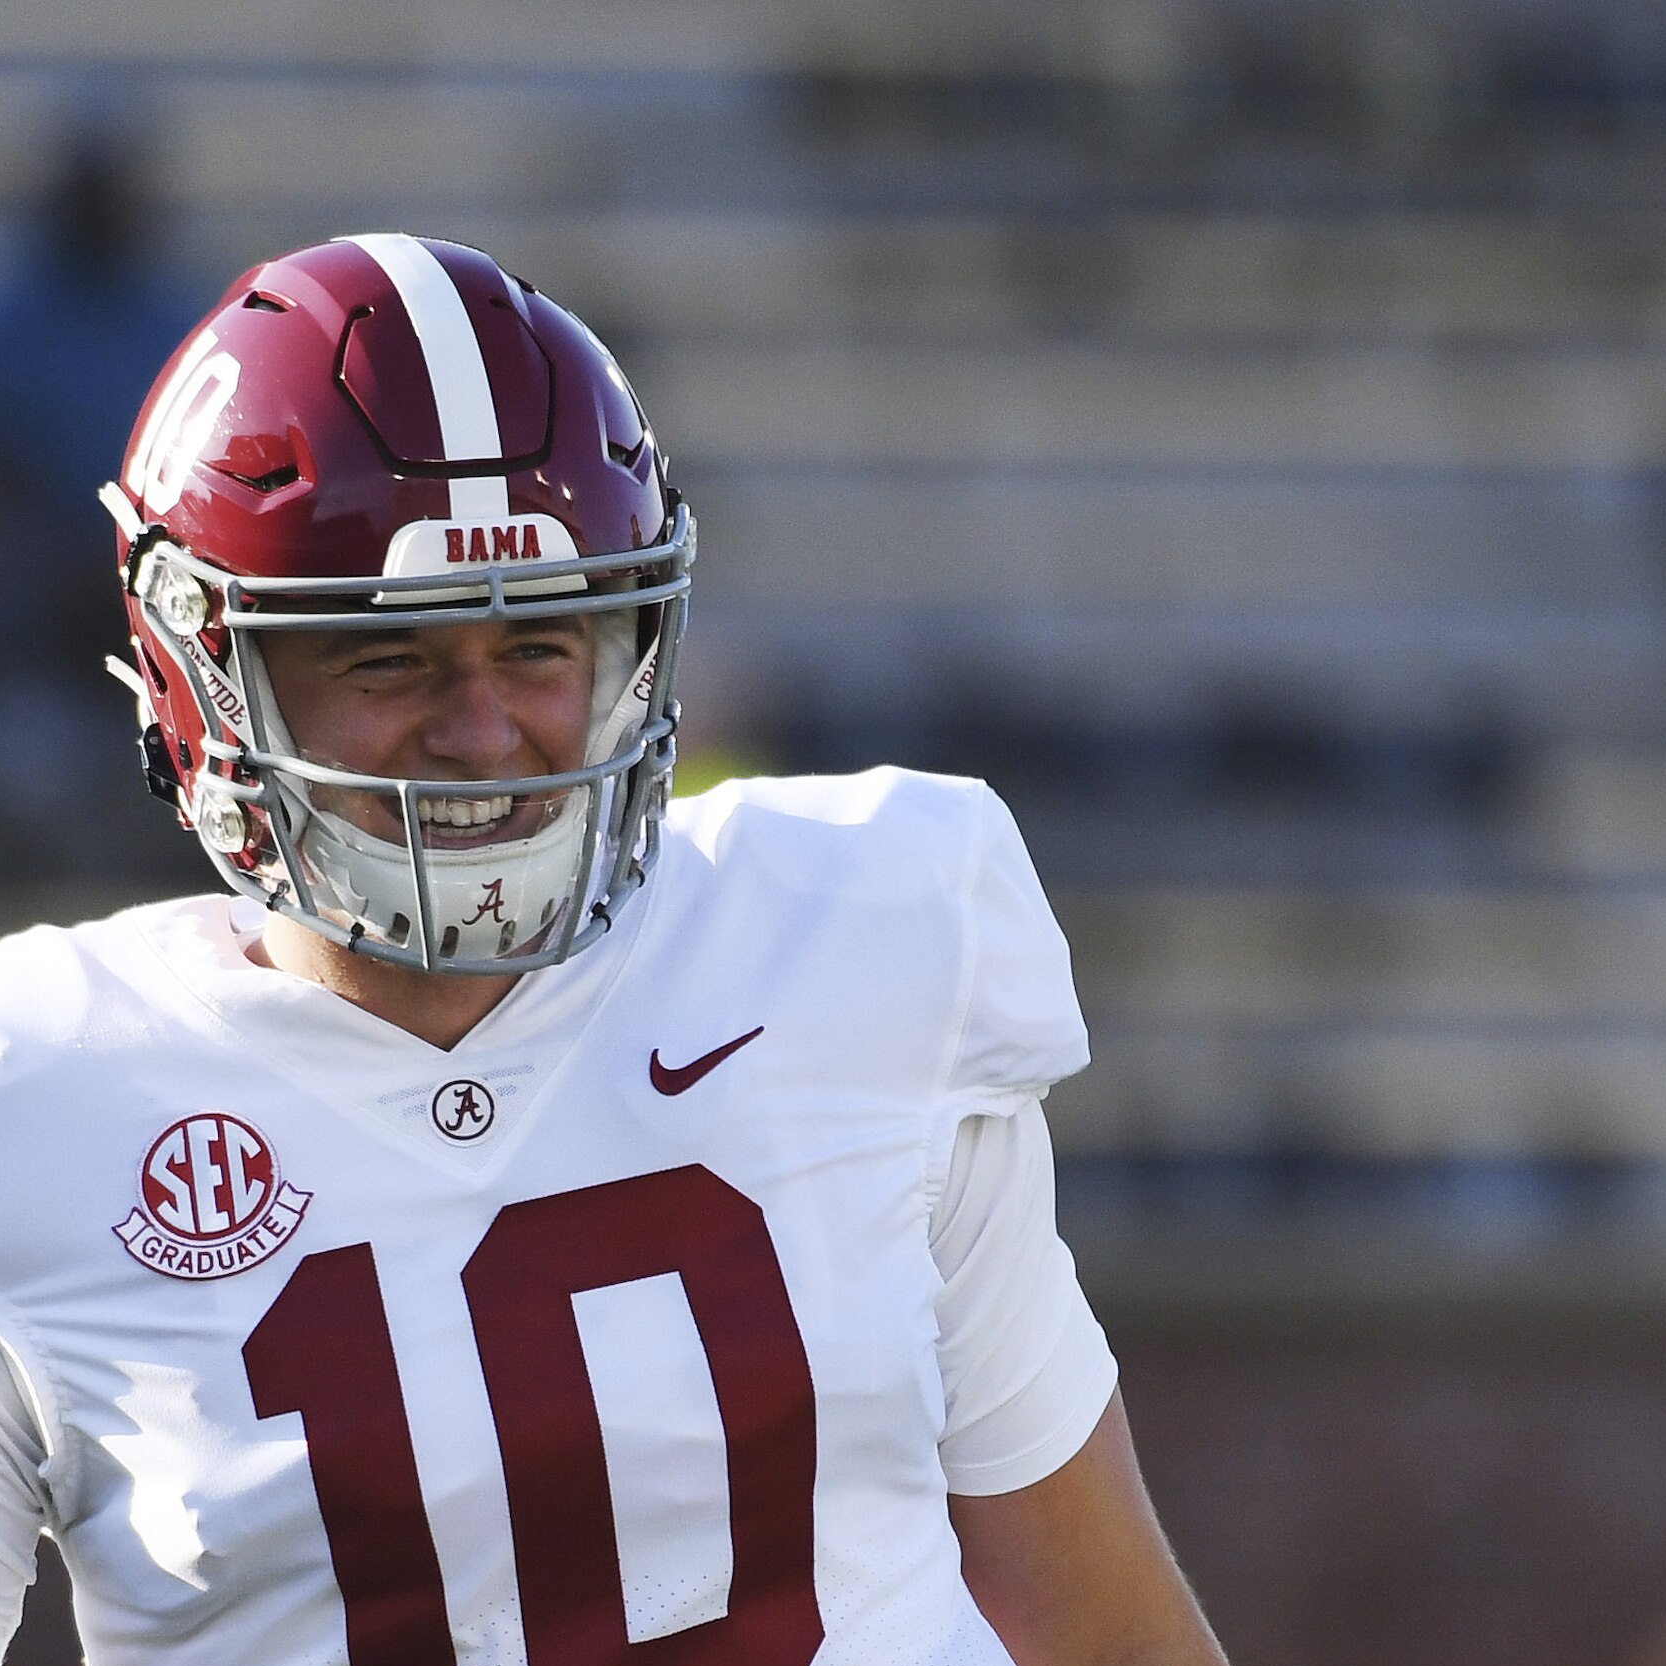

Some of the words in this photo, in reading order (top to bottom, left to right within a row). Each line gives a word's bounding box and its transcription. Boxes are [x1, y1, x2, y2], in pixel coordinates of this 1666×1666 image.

[127, 329, 242, 516] 10
[445, 524, 541, 562] BAMA
[206, 672, 249, 726] TIDE
[462, 878, 506, 925] A
[445, 1086, 484, 1131] A
[148, 1118, 267, 1235] SEC
[141, 1216, 287, 1274] GRADUATE
